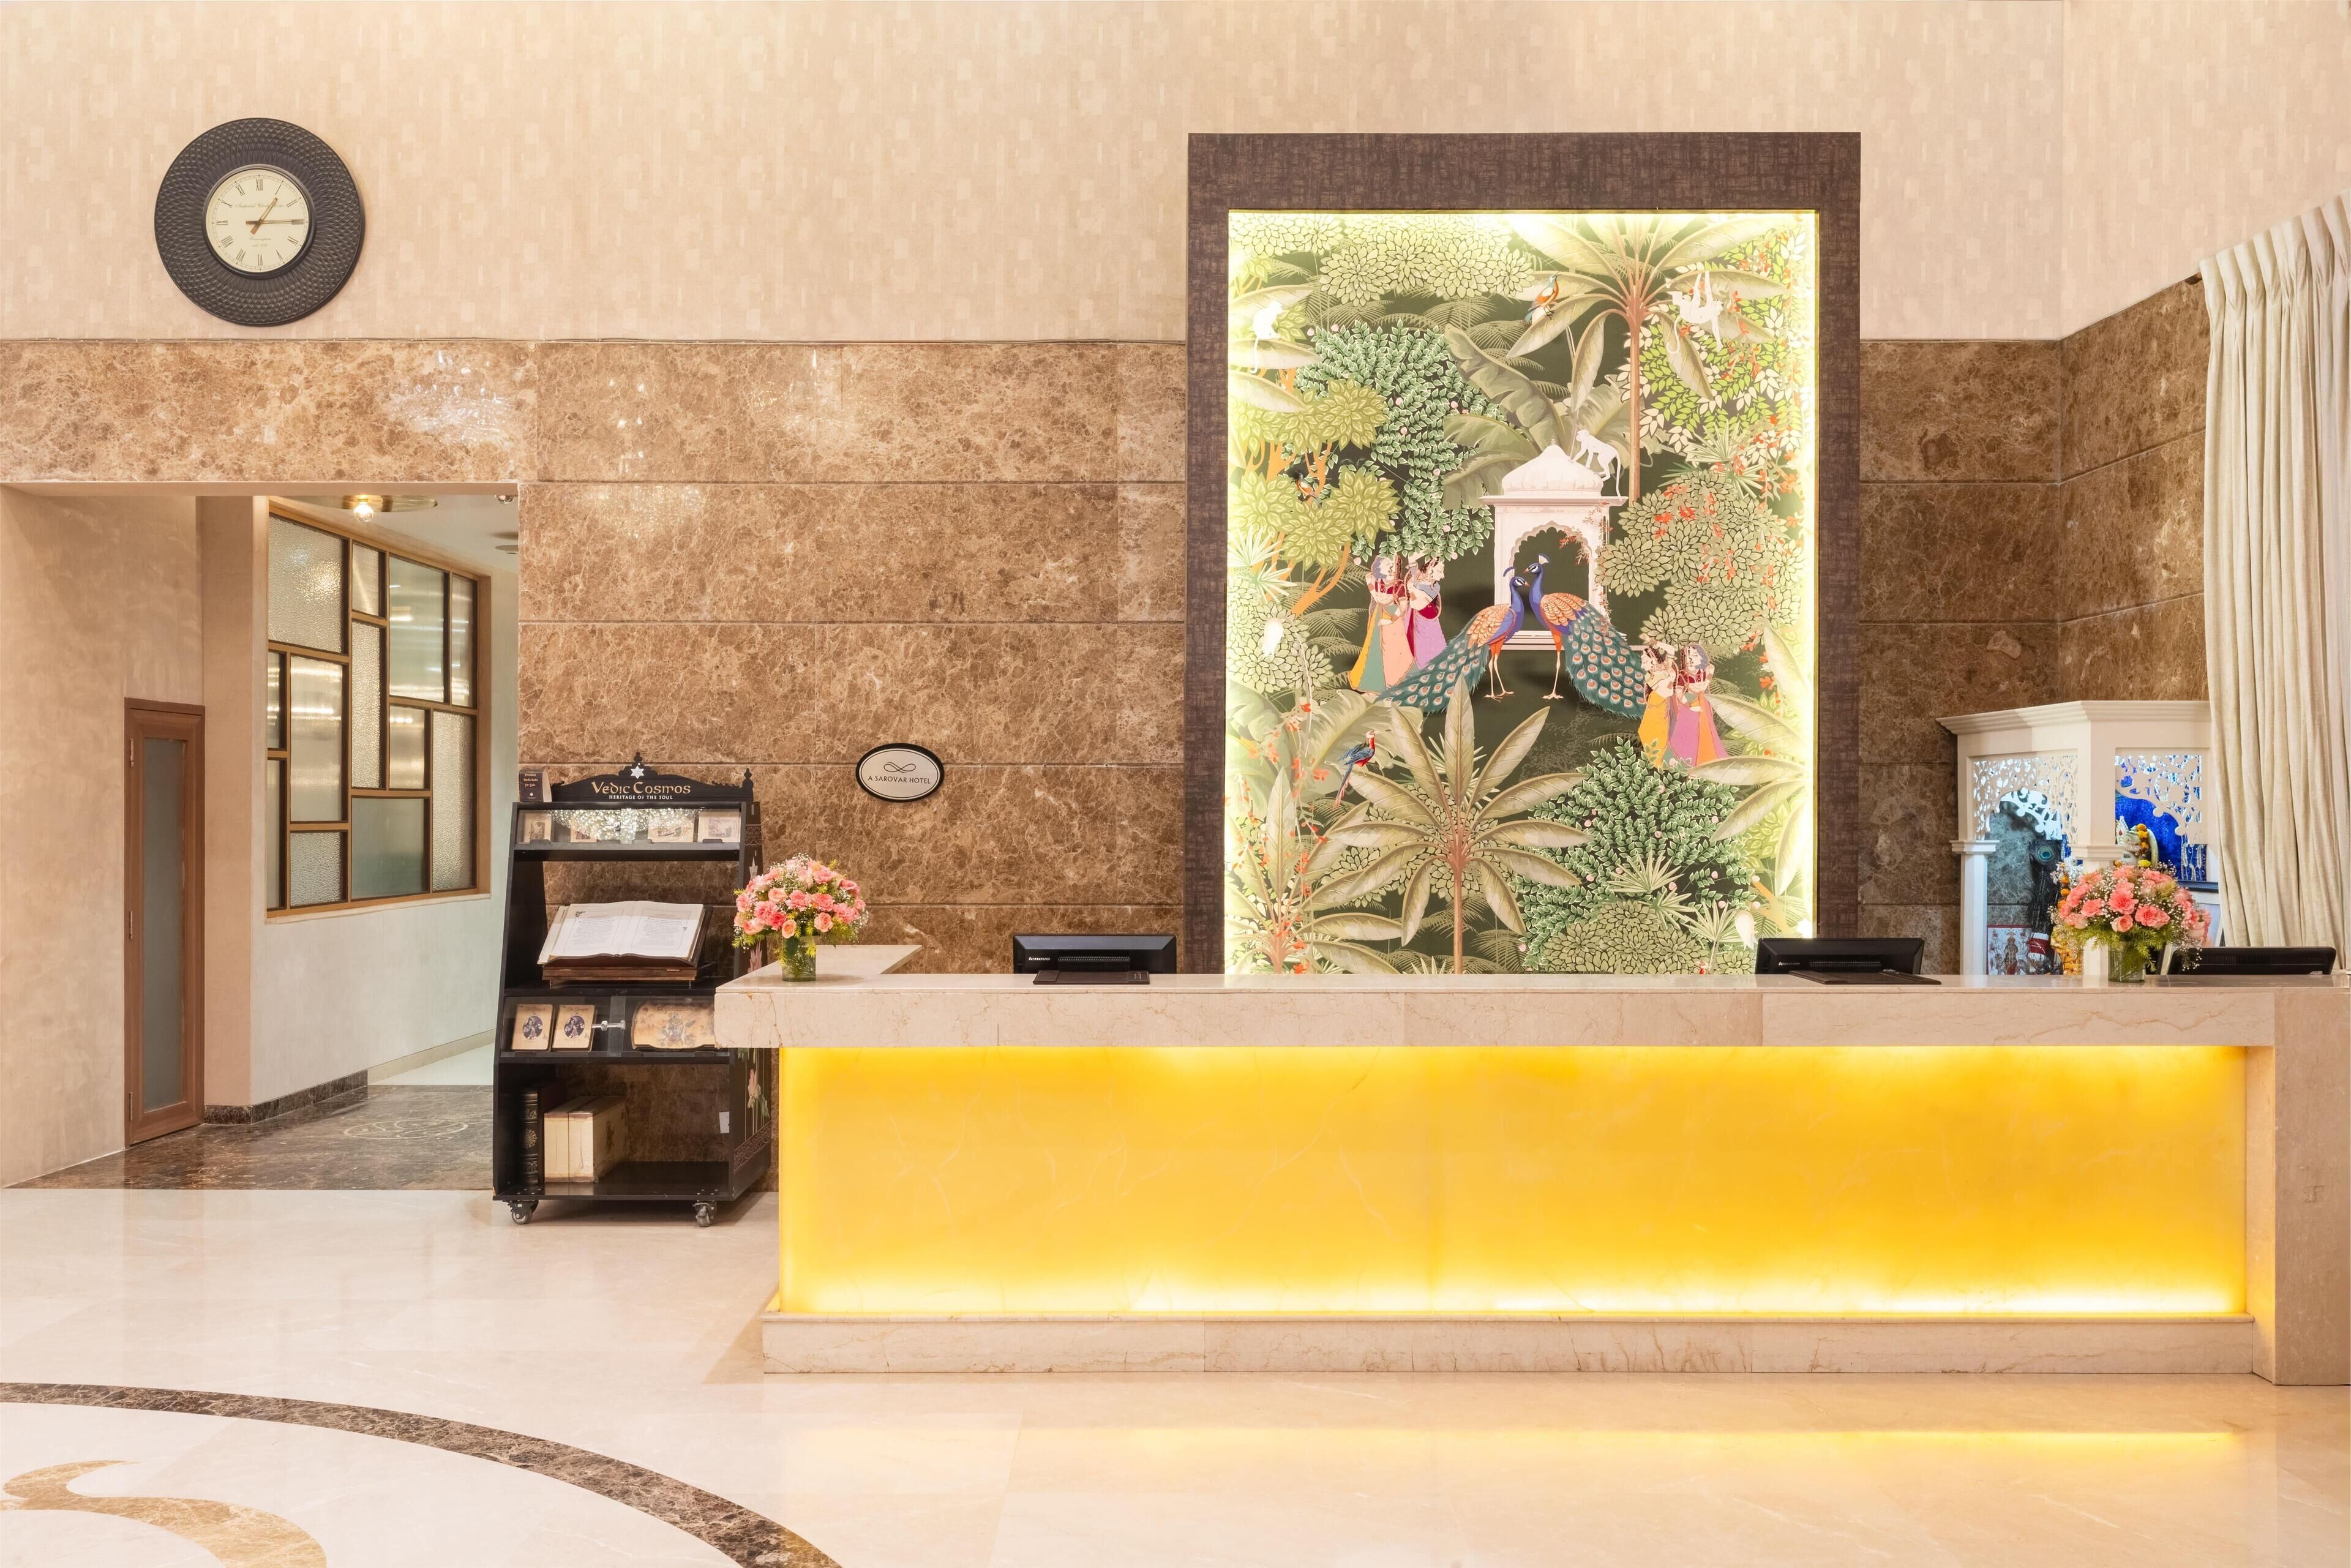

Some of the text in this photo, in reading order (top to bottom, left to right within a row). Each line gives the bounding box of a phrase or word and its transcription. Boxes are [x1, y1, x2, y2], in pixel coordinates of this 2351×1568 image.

[235, 184, 246, 197] XI
[591, 781, 691, 794] Vedic Cosmos
